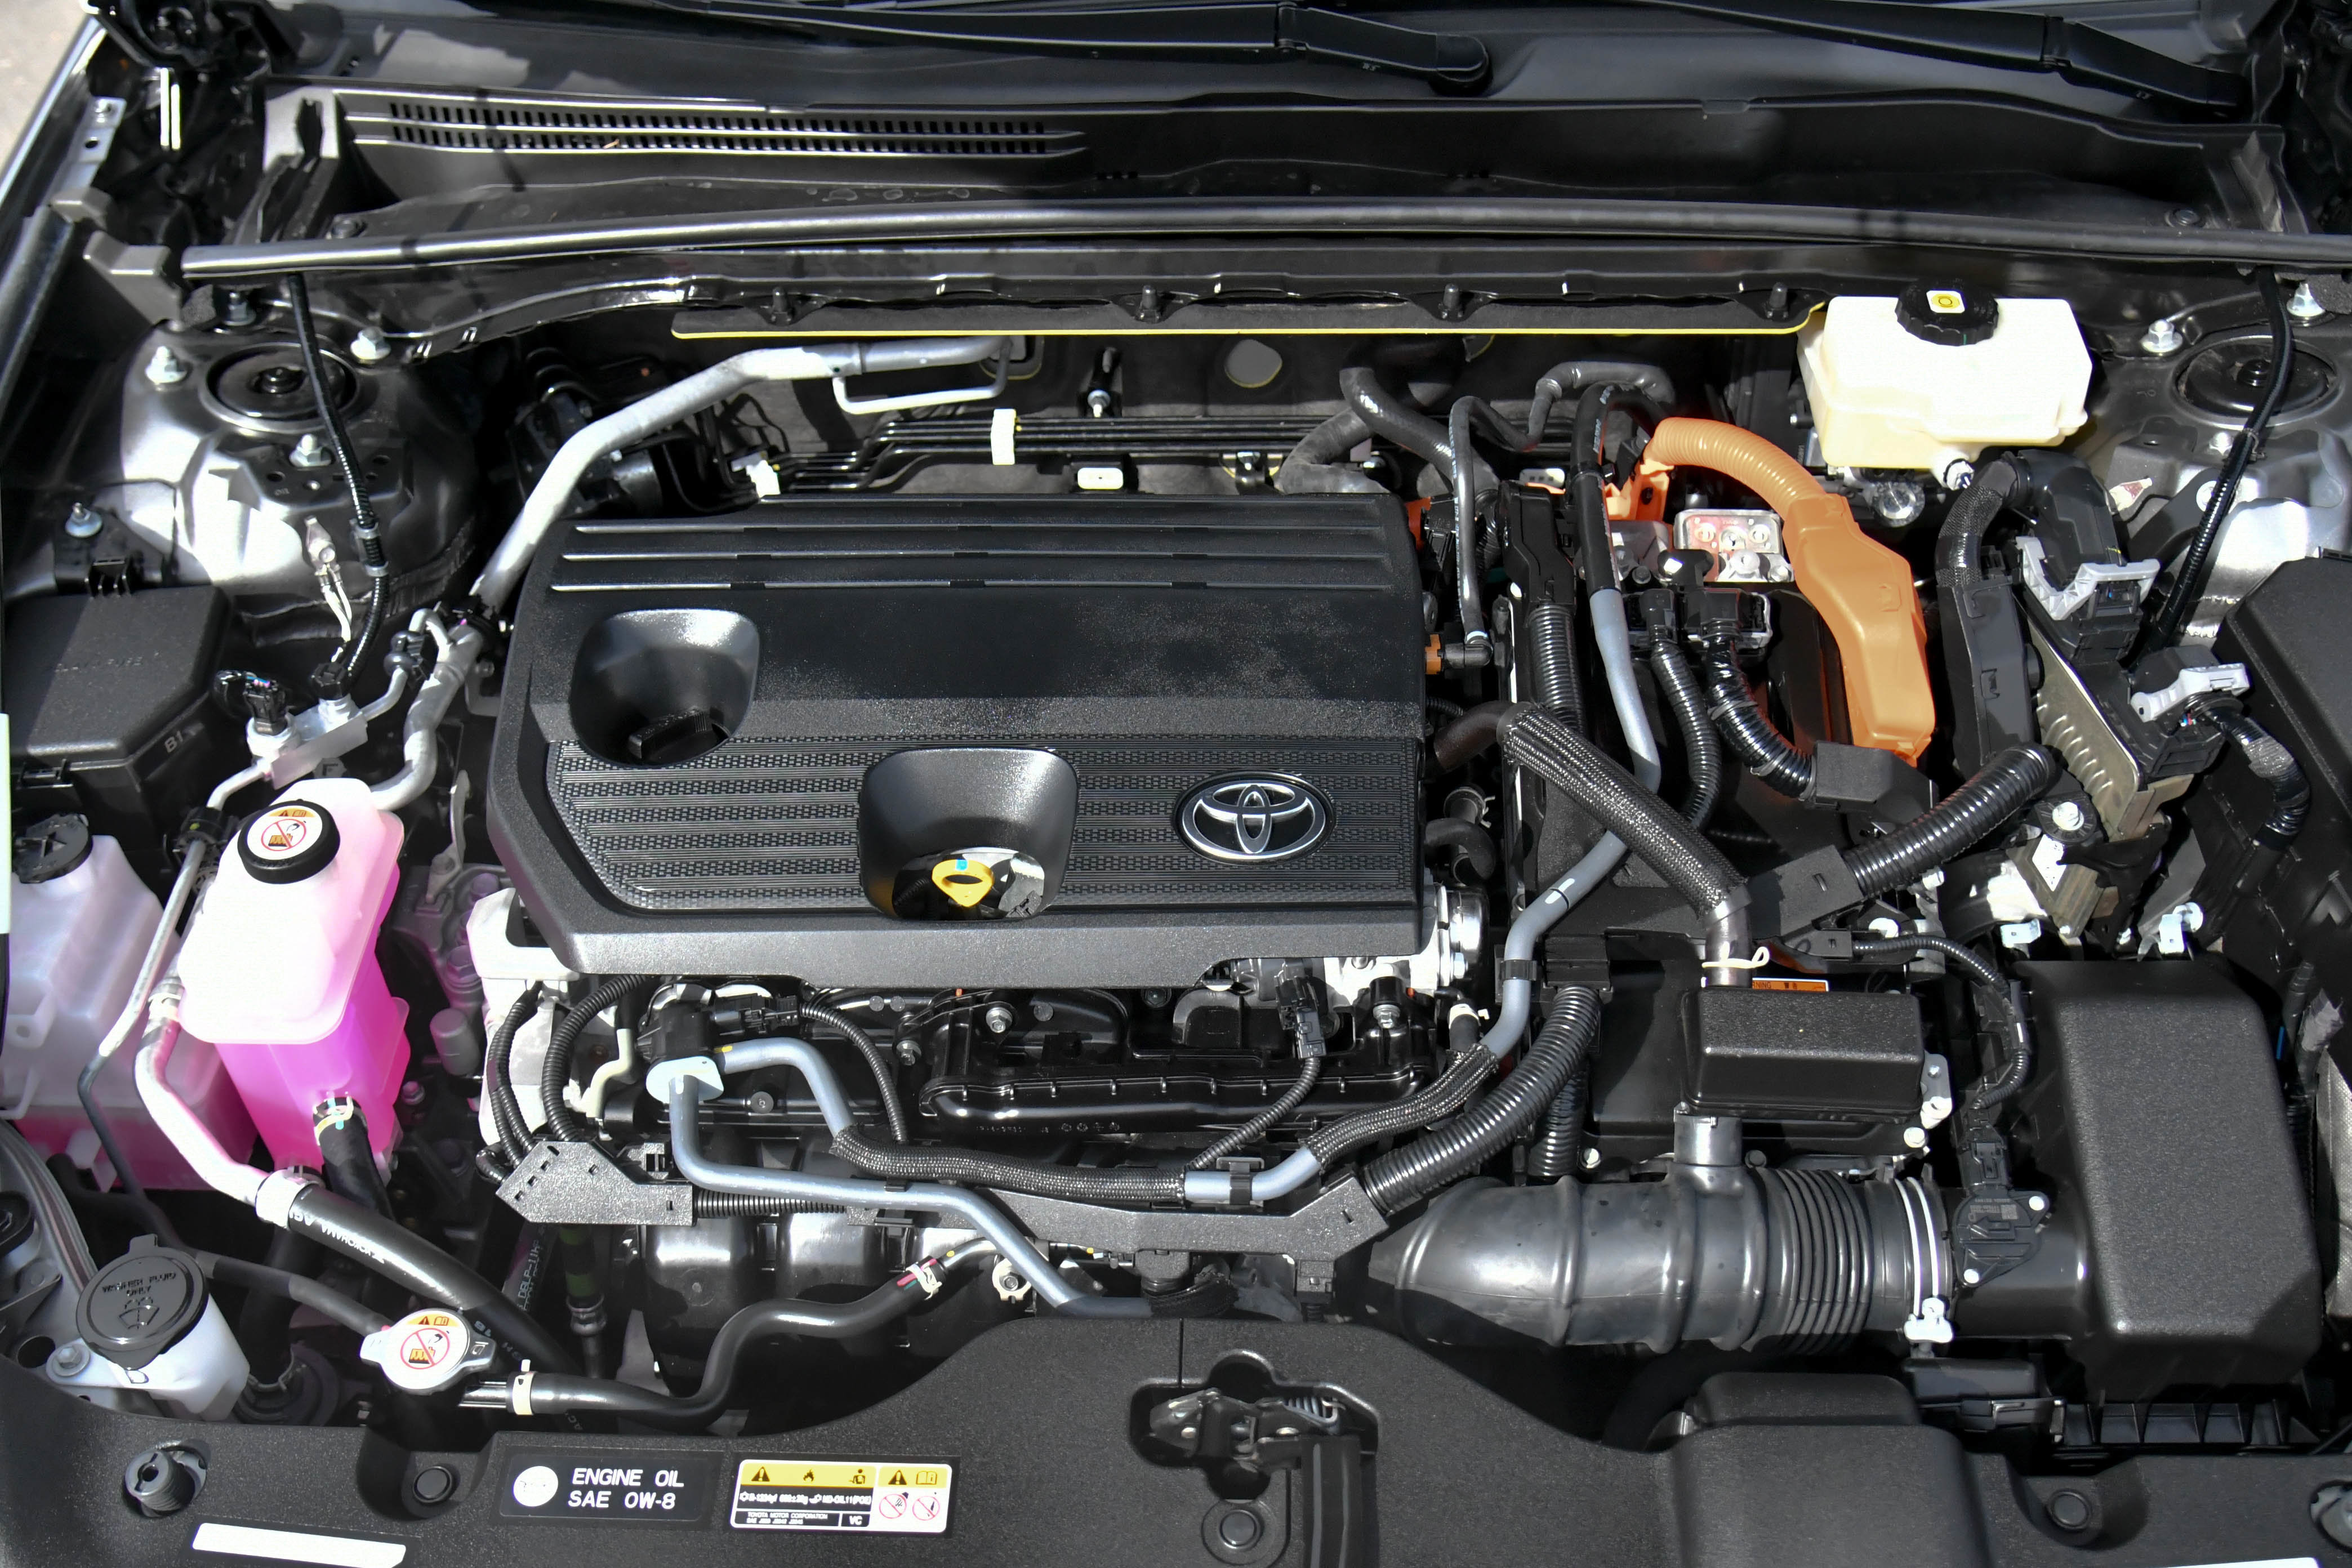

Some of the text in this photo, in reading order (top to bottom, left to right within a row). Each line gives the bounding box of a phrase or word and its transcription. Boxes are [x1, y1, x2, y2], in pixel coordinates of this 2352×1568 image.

[572, 1468, 684, 1487] ENGINE OIL
[568, 1490, 676, 1509] SAE 0W-8
[849, 1516, 863, 1525] VC
